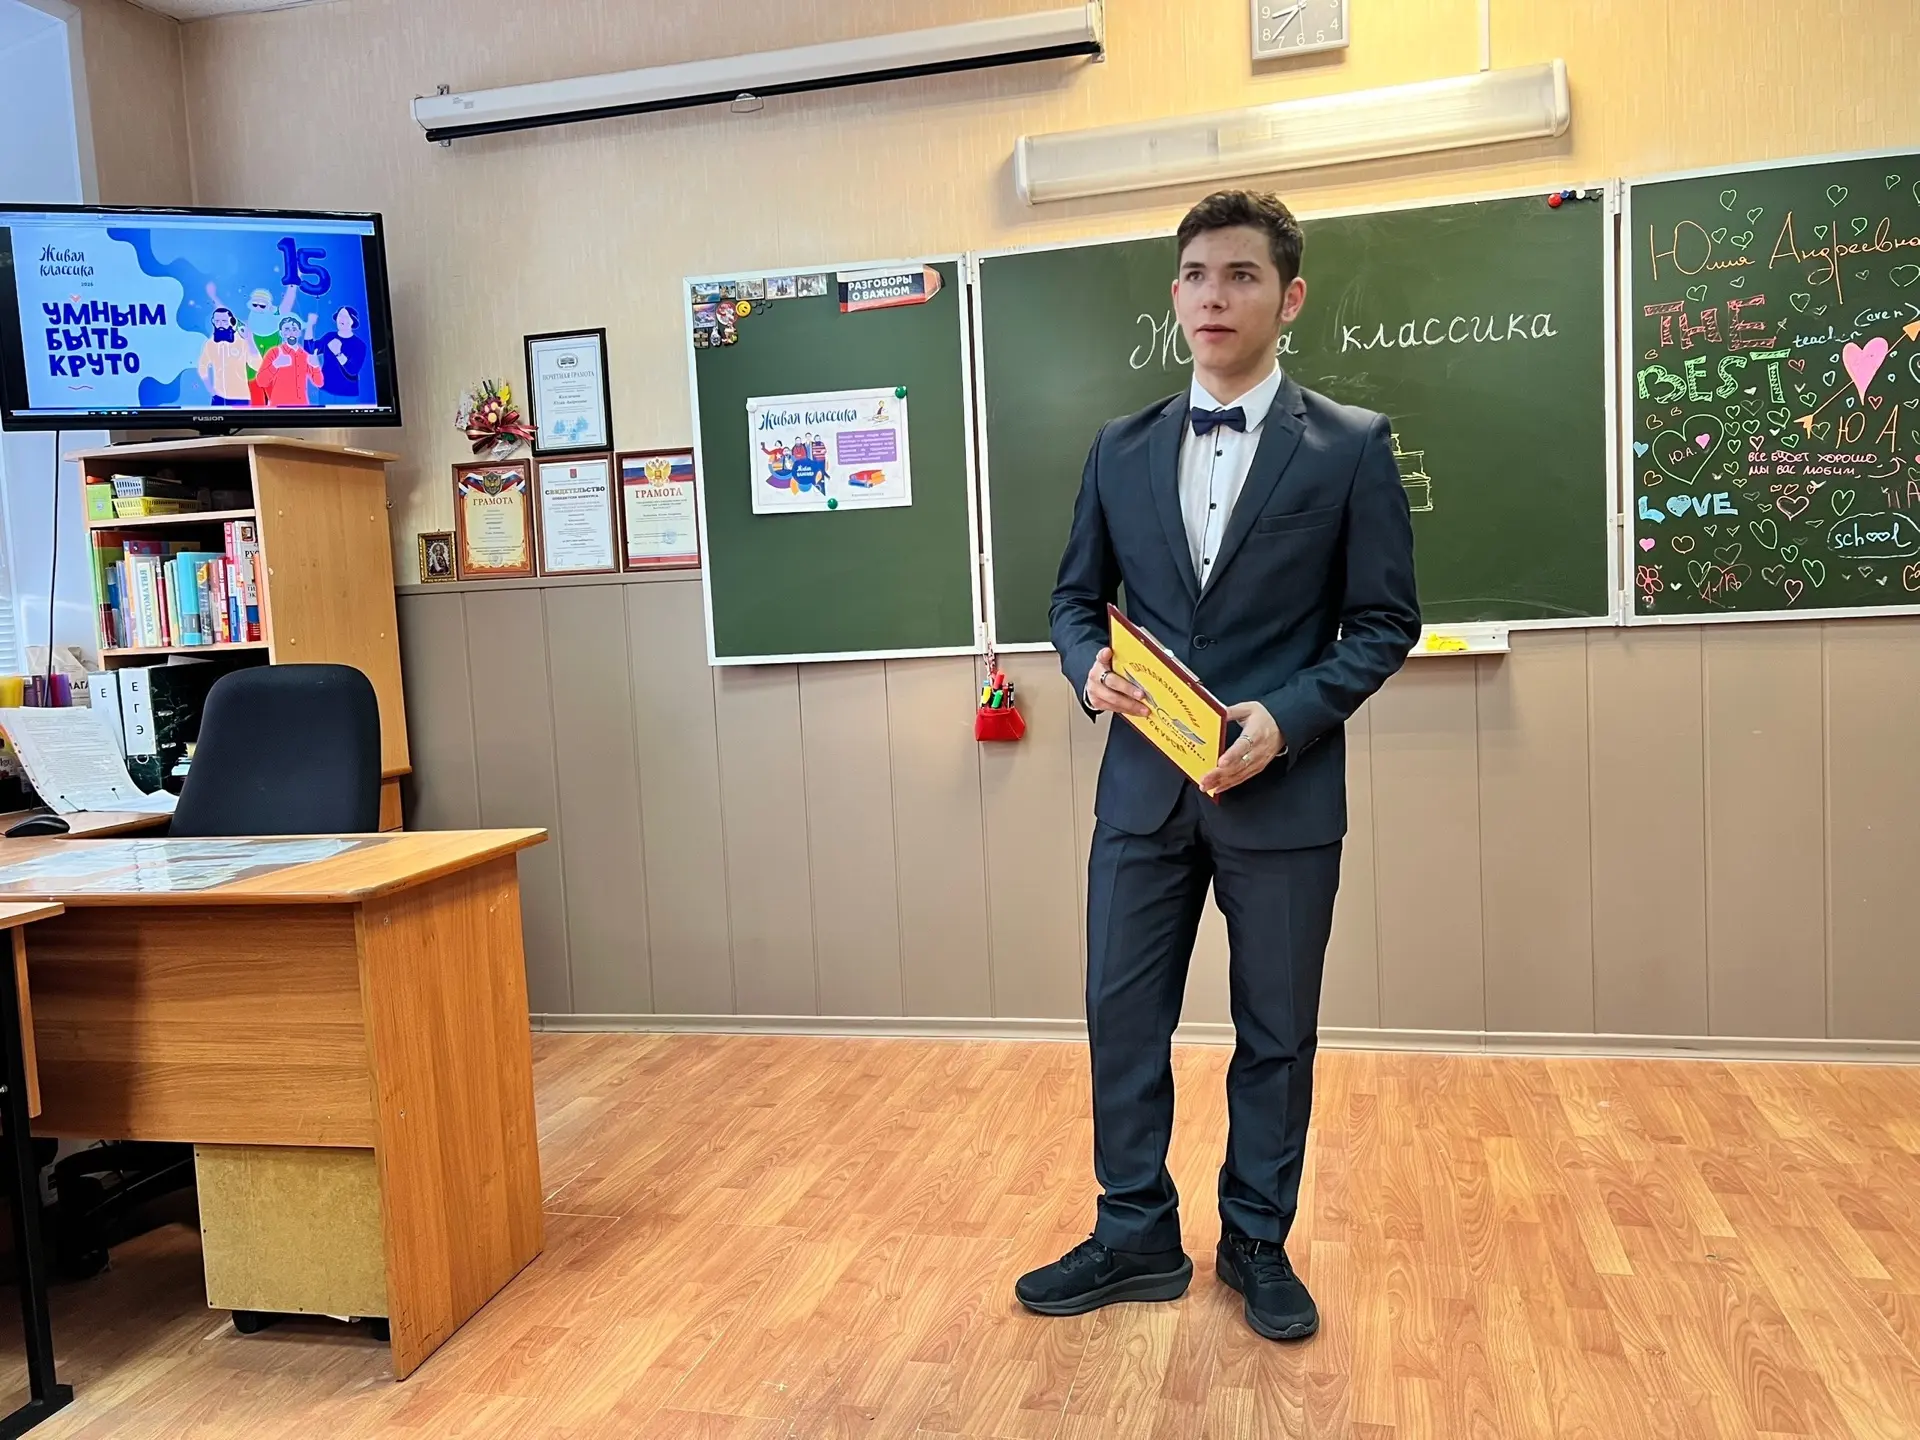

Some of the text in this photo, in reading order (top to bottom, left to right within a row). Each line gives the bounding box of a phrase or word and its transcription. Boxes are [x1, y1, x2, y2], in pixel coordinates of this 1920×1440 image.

[1261, 6, 1271, 19] 9
[1329, 17, 1339, 31] 4
[1262, 28, 1272, 42] 8
[1276, 35, 1285, 49] 7
[1296, 33, 1306, 46] 6
[1316, 30, 1325, 44] 5
[38, 243, 86, 263] Живая
[1650, 211, 1920, 305] Юлия Андреевна
[39, 264, 95, 277] классика
[276, 236, 332, 297] 15
[847, 274, 913, 291] РАЗГОВОРЫ
[852, 285, 911, 301] О ВАЖНОМ
[42, 301, 167, 327] УМНЫМ
[1644, 294, 1777, 351] THE
[45, 326, 129, 352] БЫТЬ
[1340, 310, 1559, 355] классика
[48, 352, 141, 378] КРУТО
[1636, 348, 1792, 404] BEST
[758, 408, 858, 431] Живая классика
[472, 496, 514, 506] ГРАМОТА
[544, 485, 606, 496] СВИДЕТЕЛЬСТВО
[635, 487, 683, 499] ГРАМОТА
[1637, 492, 1739, 524] LOVE
[1834, 522, 1912, 550] school
[139, 569, 154, 634] ХРЕСТОМАТИЯ
[1145, 716, 1188, 756] СКУРСИЯ
